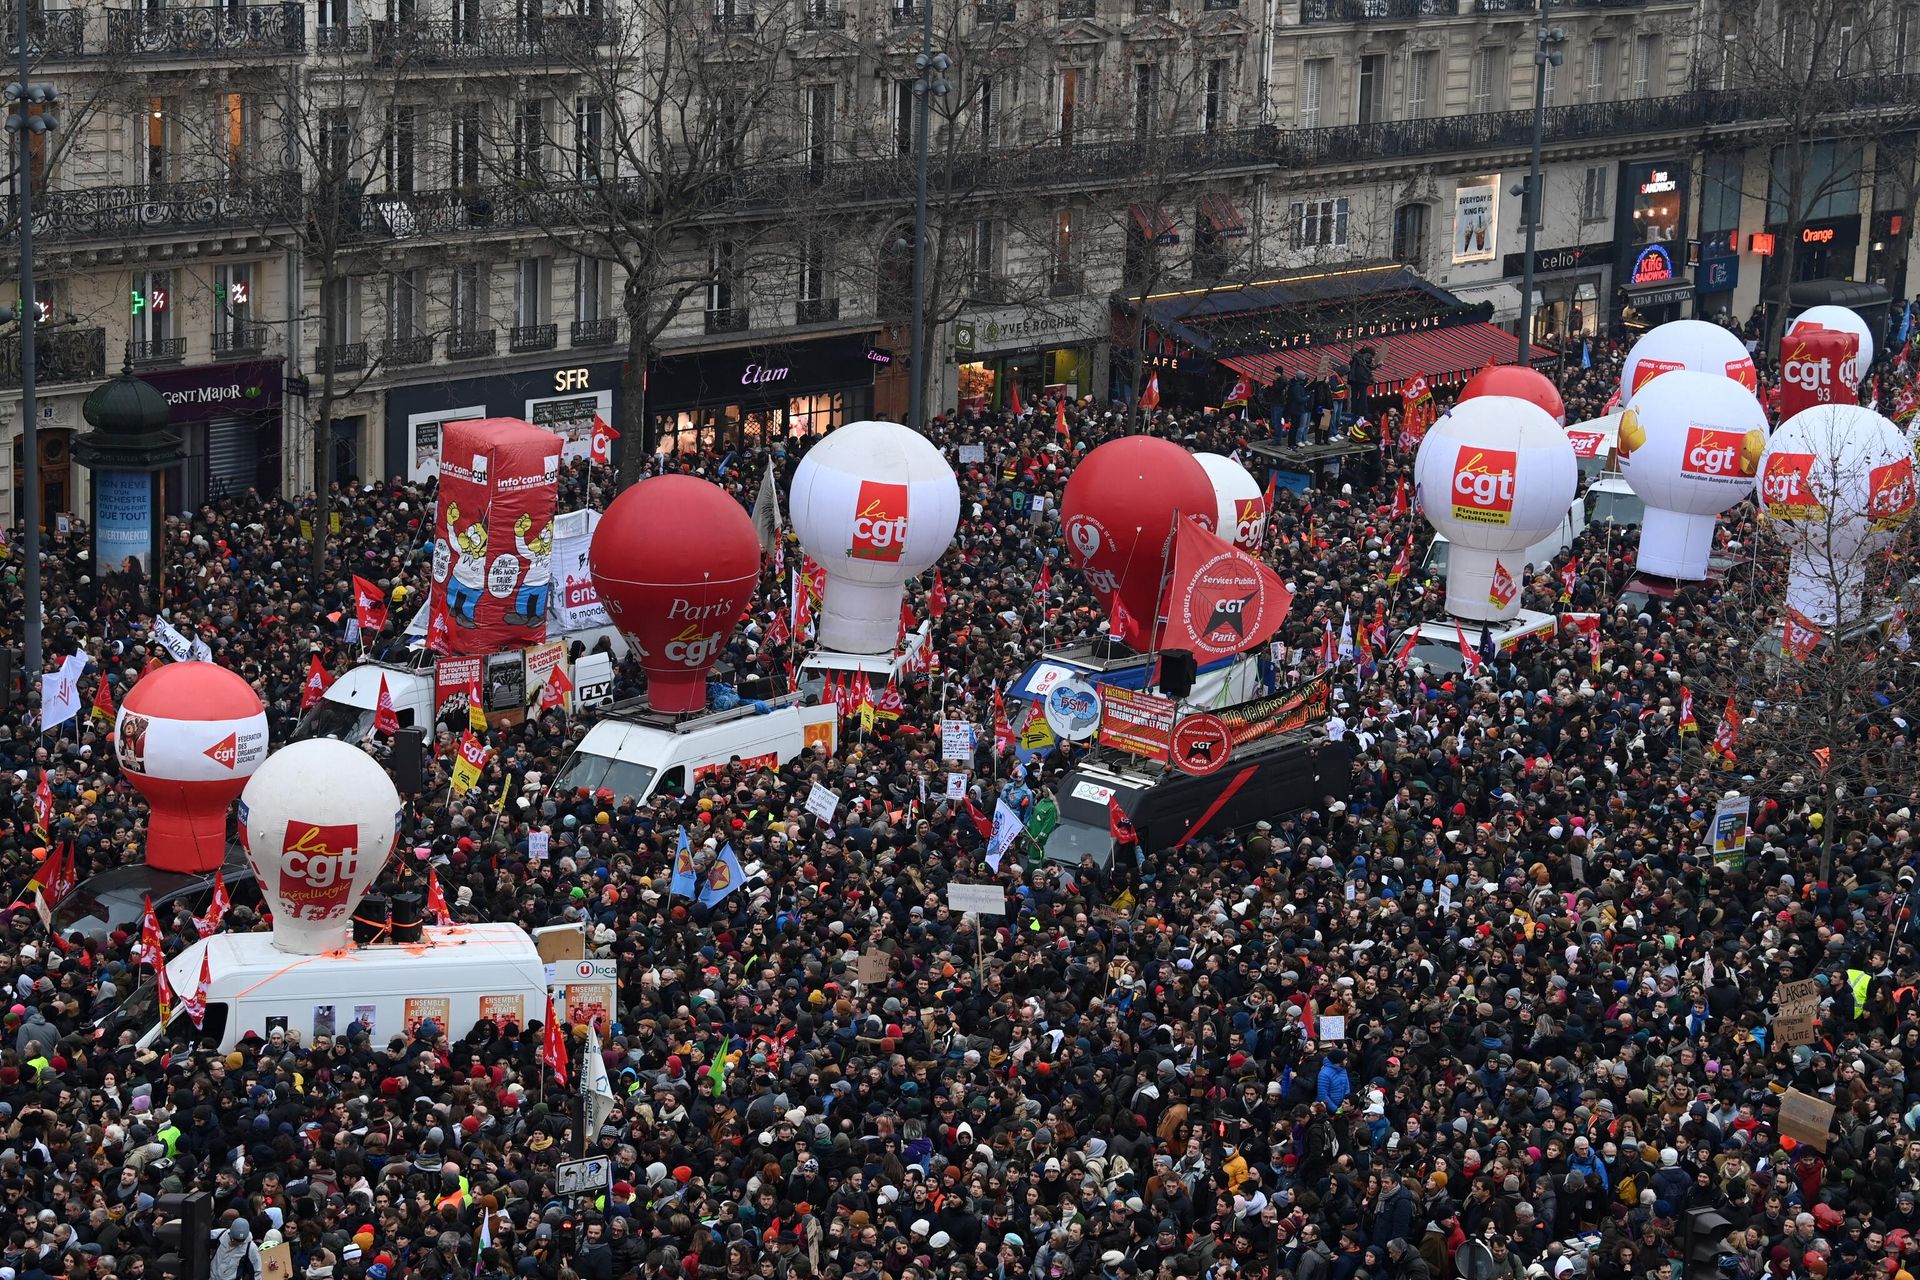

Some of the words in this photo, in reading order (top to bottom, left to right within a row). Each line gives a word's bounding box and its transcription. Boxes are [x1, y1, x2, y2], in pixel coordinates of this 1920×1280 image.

[1641, 180, 1676, 194] SANDWICH
[1459, 195, 1487, 205] EVERYDAY
[1803, 228, 1834, 243] Orange
[1542, 252, 1574, 269] celio
[1635, 269, 1670, 284] SANDWICH
[1633, 295, 1652, 306] KEBAB
[1654, 292, 1672, 302] TACOS
[1674, 290, 1691, 300] PIZZA
[1001, 320, 1029, 335] YVES
[867, 350, 890, 363] Etam
[555, 368, 589, 392] SFR
[741, 363, 789, 385] Etam
[1784, 358, 1831, 391] cgt
[1817, 387, 1831, 402] 93
[1689, 446, 1735, 474] cgt
[1455, 469, 1513, 505] cgt
[1764, 468, 1801, 502] cgt
[100, 511, 118, 520] QUE
[119, 511, 147, 521] TOUT
[1455, 512, 1506, 524] Publiques
[1457, 506, 1504, 518] Finances
[98, 528, 148, 541] DIVERTIMENTO
[854, 516, 907, 547] cgt
[1083, 569, 1121, 593] cgt
[1203, 575, 1233, 585] Services
[1234, 575, 1256, 585] Publics
[667, 598, 733, 621] Paris
[1215, 598, 1245, 613] CGT
[569, 610, 577, 620] le
[578, 606, 607, 619] monde
[1211, 631, 1236, 642] Paris
[664, 631, 722, 667] cgt
[440, 659, 480, 669] TRAVAILLEURS
[529, 663, 537, 671] TA
[582, 682, 611, 699] FLY
[1105, 687, 1133, 700] ENSEMBLE
[1060, 696, 1089, 713] FSM
[1108, 709, 1133, 723] EXIGEONS
[1132, 717, 1149, 726] MIEUX
[1149, 720, 1156, 728] ET
[1156, 721, 1169, 732] PLUS
[237, 732, 263, 743] FÉDÉRATION
[237, 746, 263, 757] ORGANISMES
[1191, 741, 1211, 750] CGT
[213, 747, 235, 763] cgt
[236, 755, 256, 764] SOCIAUX
[462, 741, 488, 765] cgt
[1191, 757, 1207, 765] Paris
[281, 847, 359, 888] cgt
[281, 882, 351, 901] métallurgie
[595, 963, 616, 975] loca
[571, 985, 606, 994] ENSEMBLE
[1778, 980, 1814, 1004] L'ARGENT
[410, 999, 445, 1008] ENSEMBLE
[485, 996, 520, 1005] ENSEMBLE
[571, 995, 603, 1003] RETRAITE
[410, 1009, 442, 1017] RETRAITE
[485, 1006, 517, 1015] RETRAITE
[1776, 1033, 1786, 1044] LA
[1786, 1030, 1810, 1042] LUTTE
